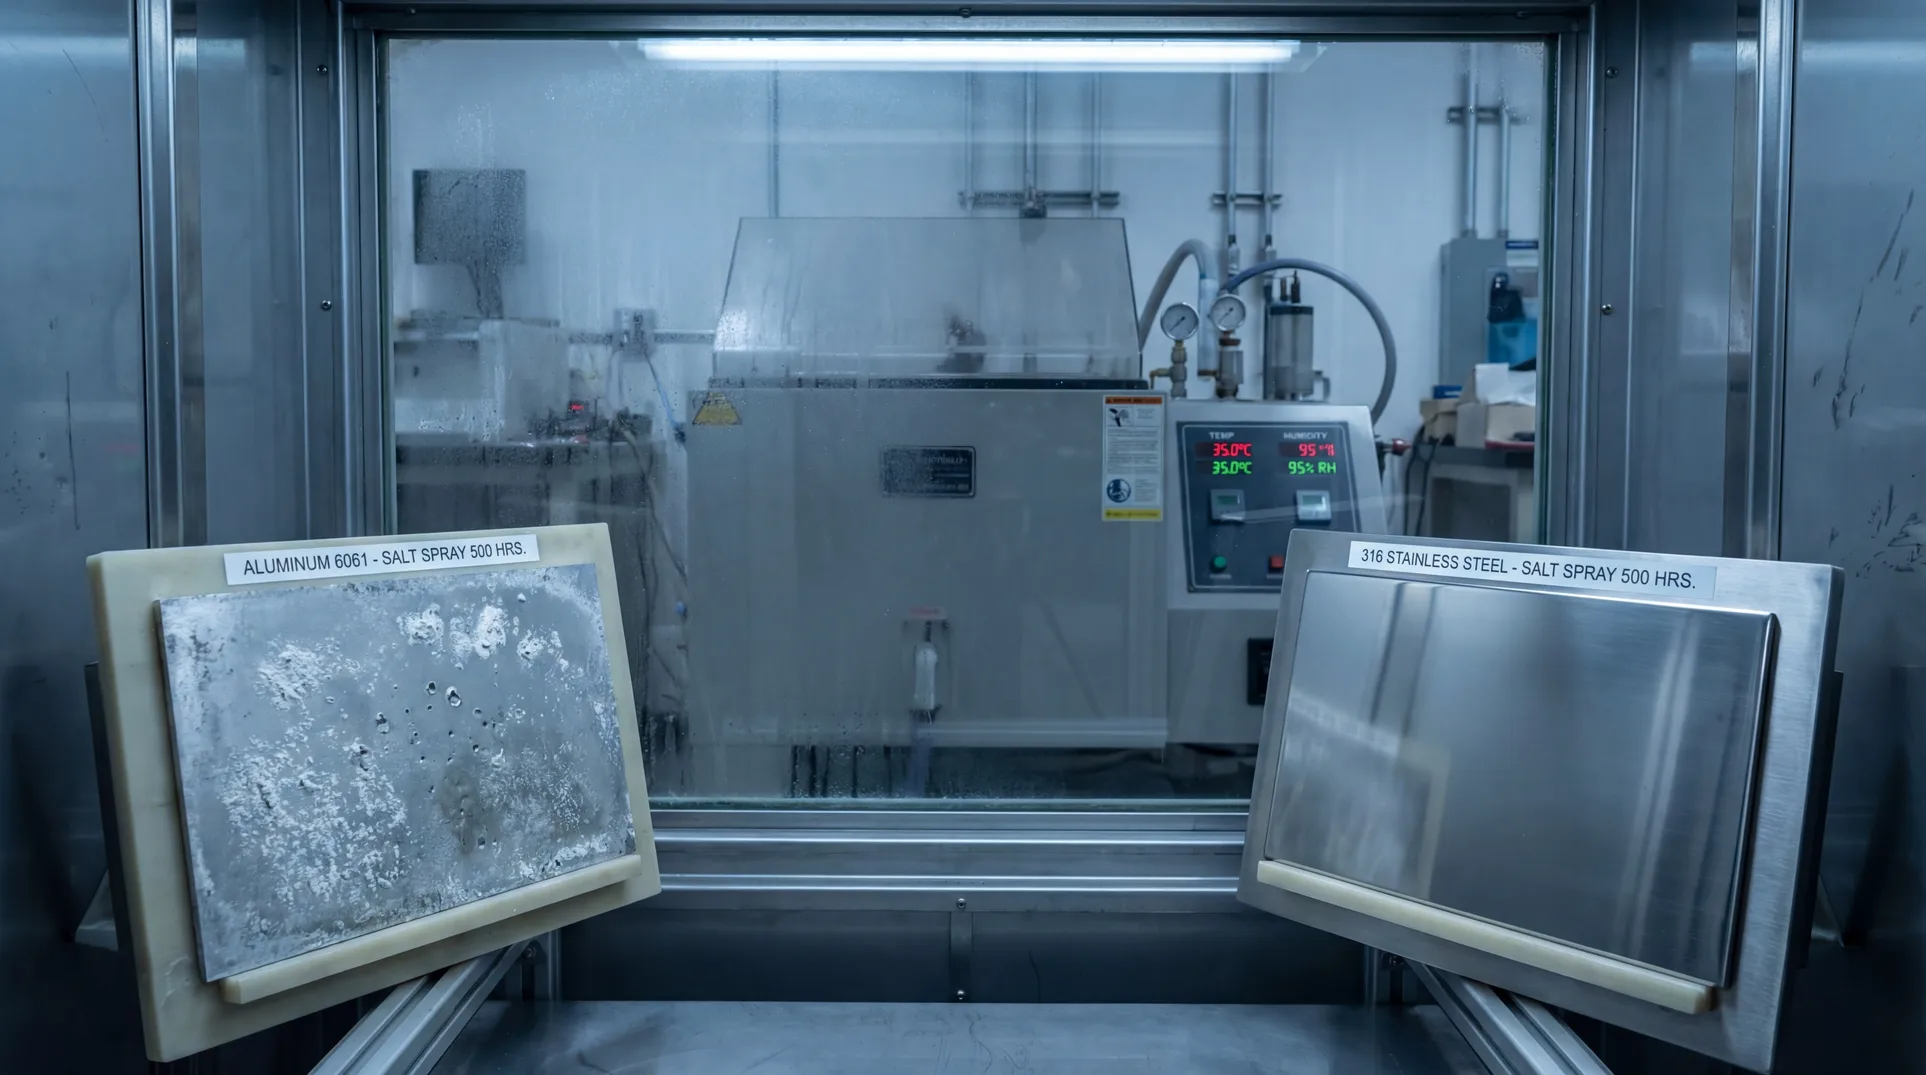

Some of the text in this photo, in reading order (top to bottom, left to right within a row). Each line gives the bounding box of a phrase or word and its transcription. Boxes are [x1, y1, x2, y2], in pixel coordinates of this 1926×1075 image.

[1299, 443, 1316, 456] 95
[1288, 461, 1336, 474] 95% RH
[244, 554, 330, 576] ALUMINUM
[335, 552, 368, 569] 6061
[382, 548, 417, 566] SALT
[421, 546, 466, 562] SPRAY
[470, 544, 493, 559] 500
[496, 542, 527, 556] HRS.
[1361, 548, 1384, 564] 316
[1386, 550, 1460, 570] STAINLESS
[1462, 556, 1508, 574] STEEL
[1521, 560, 1560, 578] SALT
[1562, 564, 1618, 582] SPRAY
[1620, 568, 1650, 585] 500
[1654, 572, 1696, 589] HRS.
